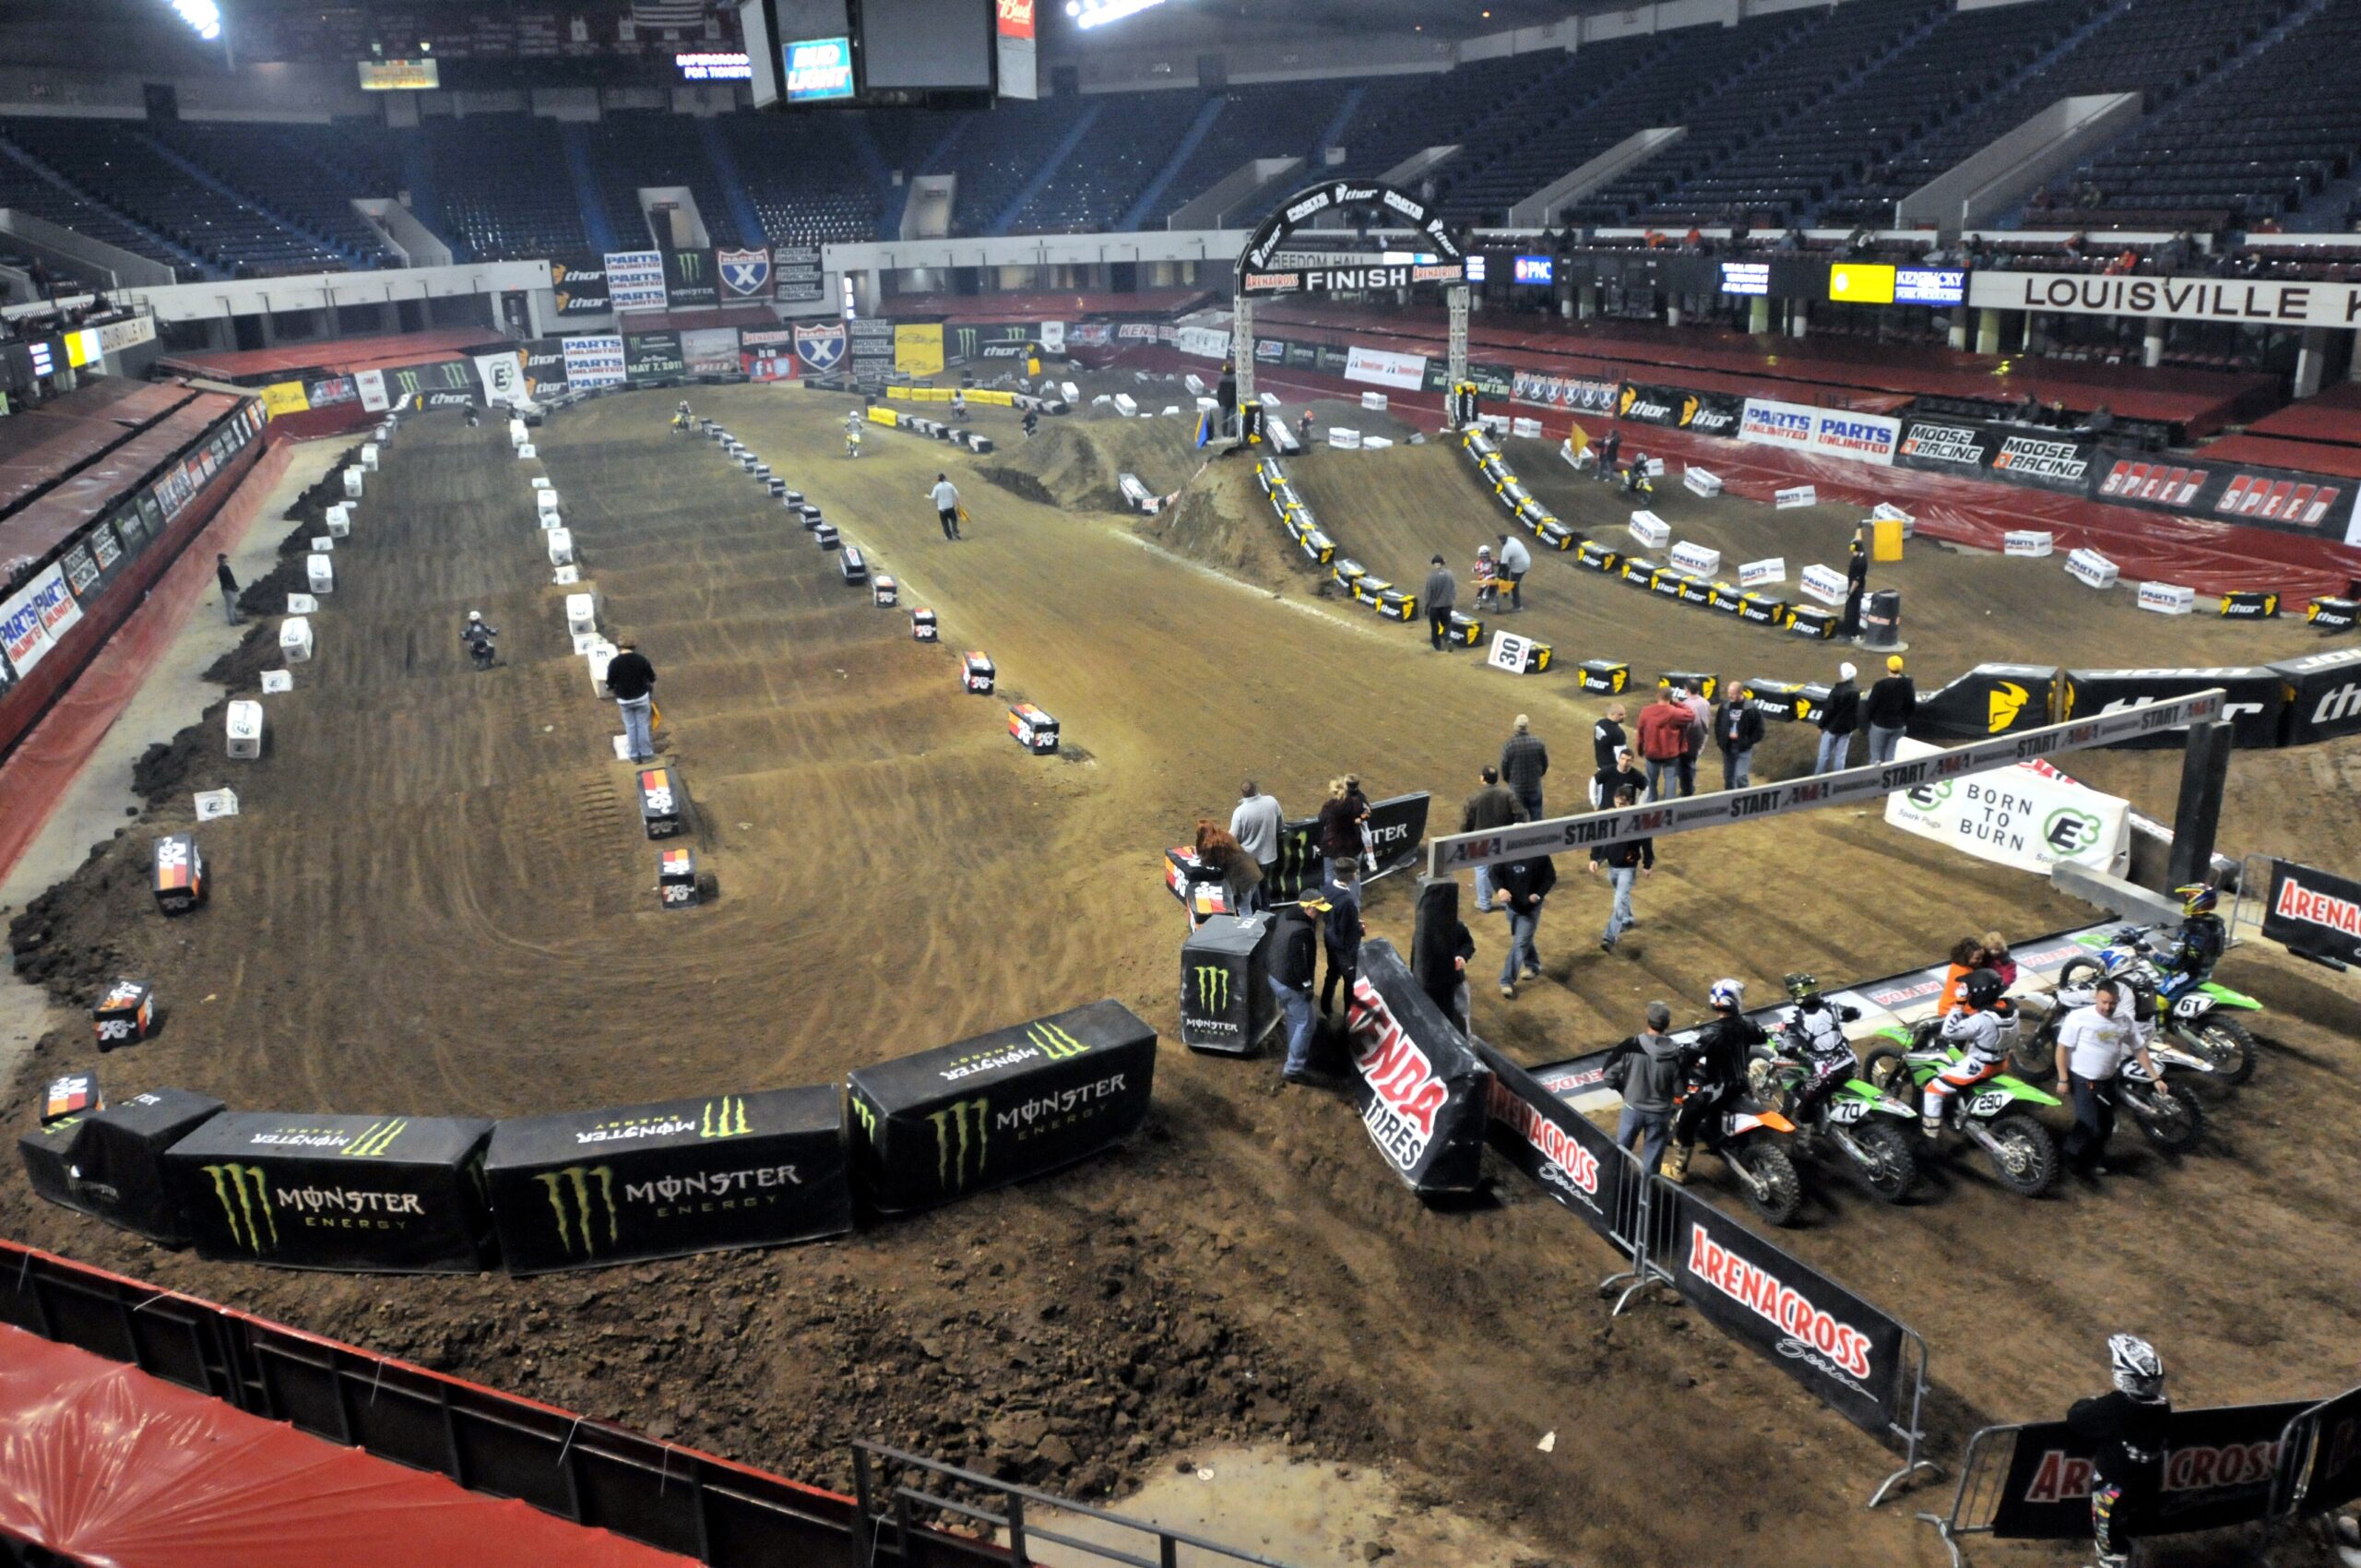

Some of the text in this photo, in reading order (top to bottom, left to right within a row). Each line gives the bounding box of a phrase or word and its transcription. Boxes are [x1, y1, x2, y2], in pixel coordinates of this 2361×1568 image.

[793, 44, 840, 67] BUD
[684, 66, 706, 78] FOR
[787, 65, 850, 90] LIGHT
[1346, 189, 1378, 200] thor
[1261, 223, 1282, 258] thor
[1433, 232, 1459, 257] thor
[606, 254, 659, 264] PARTS
[607, 262, 660, 270] UNLIMITED
[721, 255, 765, 263] RACER
[564, 270, 604, 282] thor
[609, 272, 662, 282] PARTS
[734, 265, 756, 285] X
[1412, 265, 1463, 282] ARENACROSS
[1527, 261, 1551, 279] PNC
[610, 280, 662, 289] UNLIMITED
[1245, 273, 1299, 290] ARENACROSS
[1306, 268, 1406, 291] FINISH
[611, 291, 664, 301] PARTS
[671, 287, 715, 296] MONSTER
[2025, 279, 2310, 318] LOUISVILLE
[568, 297, 608, 309] thor
[612, 299, 665, 307] UNLIMITED
[742, 330, 789, 345] ARENACROSS
[799, 329, 841, 338] RACER
[564, 339, 622, 350] PARTS
[565, 348, 622, 356] UNLIMITED
[811, 340, 832, 361] X
[984, 347, 1020, 357] thor
[528, 354, 562, 366] thor
[566, 358, 623, 369] PARTS
[628, 362, 651, 373] MAY
[663, 361, 682, 370] 2011
[568, 367, 623, 375] UNLIMITED
[536, 382, 566, 394] thor
[1515, 381, 1524, 393] X
[1533, 383, 1541, 395] X
[1549, 385, 1559, 398] X
[1566, 386, 1575, 399] X
[1584, 388, 1594, 402] X
[431, 394, 471, 406] thor
[1602, 390, 1612, 404] X
[1630, 400, 1671, 419] thor
[1692, 410, 1733, 428] thor
[1748, 408, 1811, 431] PARTS
[1743, 422, 1809, 442] UNLIMITED
[1820, 418, 1892, 444] PARTS
[1910, 423, 1975, 445] MOOSE
[1818, 434, 1890, 456] UNLIMITED
[1916, 439, 1985, 463] RACING
[2004, 435, 2078, 461] MOOSE
[2008, 455, 2088, 480] RACING
[2100, 467, 2205, 505] SPEED
[2217, 482, 2334, 527] SPEED
[1540, 531, 1559, 545] thor
[2005, 539, 2035, 548] PARTS
[1583, 554, 1602, 566] thor
[1672, 552, 1707, 569] PARTS
[1627, 570, 1649, 584] thor
[1739, 565, 1767, 579] PARTS
[1657, 580, 1679, 595] thor
[1801, 573, 1836, 595] PARTS
[34, 576, 67, 613] PARTS
[1684, 588, 1708, 603] thor
[2141, 590, 2177, 604] PARTS
[1381, 604, 1400, 616] thor
[1714, 595, 1738, 612] thor
[2228, 601, 2260, 613] thor
[1745, 605, 1769, 621] thor
[2315, 611, 2351, 626] thor
[0, 601, 37, 645] PARTS
[1792, 621, 1821, 636] thor
[1499, 637, 1522, 666] 30
[1585, 676, 1609, 691] thor
[1754, 699, 1790, 715] thor
[1564, 817, 1619, 846] START
[1730, 790, 1781, 817] START
[1882, 762, 1928, 789] START
[2018, 733, 2058, 760] START
[2141, 704, 2181, 730] START
[1967, 783, 2033, 816] BORN
[1897, 807, 1941, 829] Spark Plugs
[1984, 807, 2011, 827] TO
[1959, 818, 2024, 851] BURN
[2015, 944, 2084, 968] KENDA
[1871, 980, 1943, 1006] KENDA
[2179, 998, 2201, 1013] 61
[100, 1019, 137, 1040] K&N
[1186, 1016, 1239, 1032] MONSTER
[939, 1046, 1038, 1081] MONSTER
[1348, 975, 1449, 1147] KENDA
[1541, 1067, 1605, 1094] ENDA
[996, 1073, 1127, 1132] MONSTER
[1841, 1101, 1861, 1120] 70
[1978, 1093, 2003, 1111] 290
[1017, 1104, 1108, 1142] ENERGY
[250, 1132, 350, 1146] MONSTER
[576, 1120, 695, 1144] MONSTER
[1363, 1096, 1425, 1170] TIRES
[1487, 1071, 1599, 1194] ARENACROSS
[624, 1163, 803, 1205] MONSTER
[278, 1185, 424, 1217] MONSTER
[656, 1195, 777, 1218] ENERGY
[305, 1216, 407, 1230] ENERGY
[1689, 1222, 1873, 1380] ARENACROSS
[2024, 1441, 2283, 1503] ARCROSS
